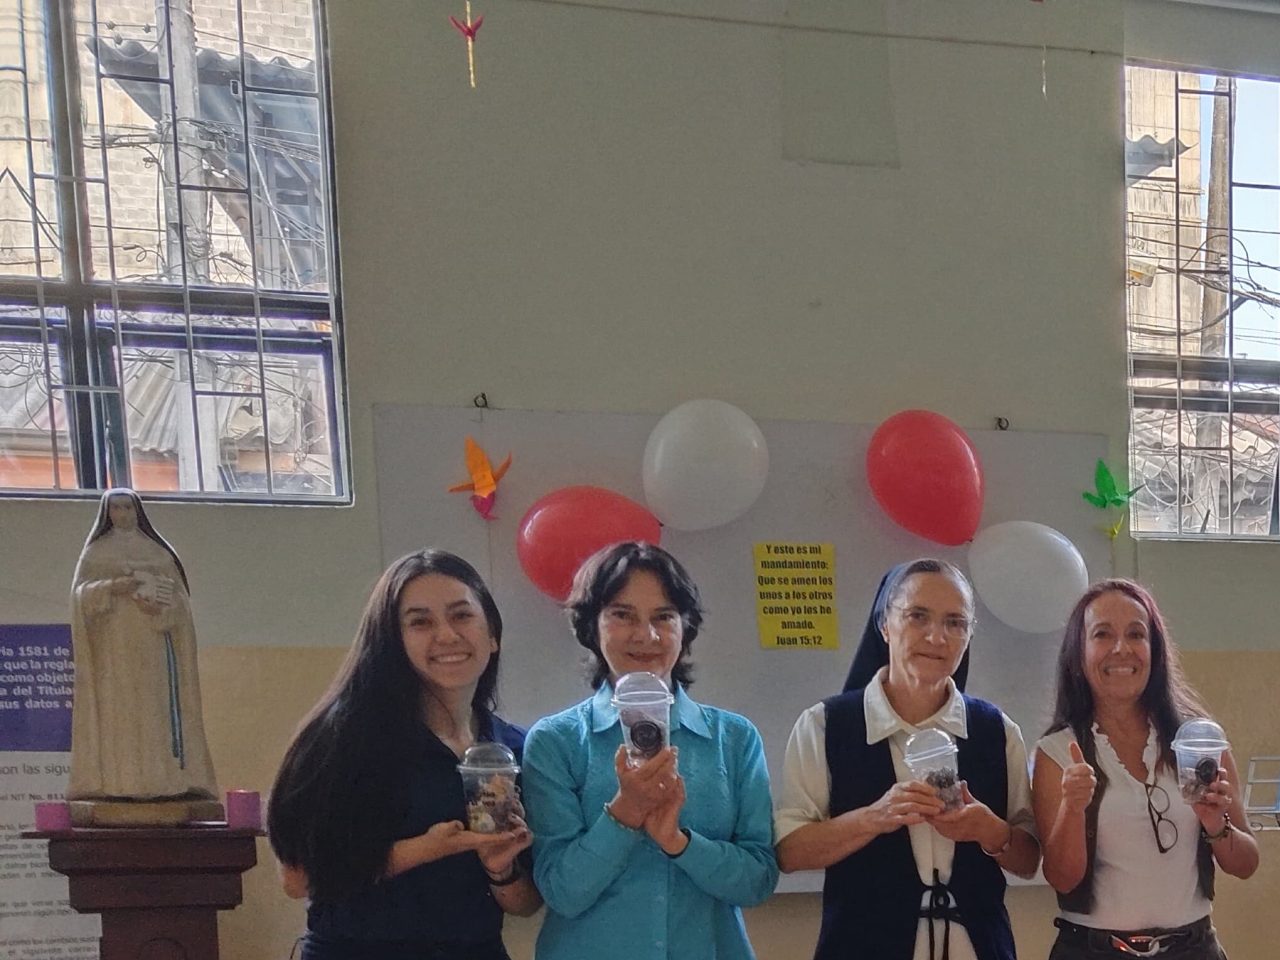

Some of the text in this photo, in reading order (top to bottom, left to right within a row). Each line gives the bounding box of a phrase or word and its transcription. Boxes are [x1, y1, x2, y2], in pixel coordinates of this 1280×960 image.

[766, 544, 822, 554] Y este es mi
[758, 575, 833, 586] Que se amen los
[760, 590, 833, 600] unos a los otros
[763, 606, 789, 615] como
[790, 606, 802, 616] yo
[820, 605, 832, 615] he
[781, 620, 815, 630] amado.
[776, 635, 822, 646] Juan 15:12
[18, 646, 50, 657] 1581
[53, 646, 70, 657] de
[3, 659, 75, 672] que la regla
[0, 674, 35, 683] como
[12, 685, 33, 696] del
[24, 698, 60, 709] datos
[23, 763, 41, 775] las
